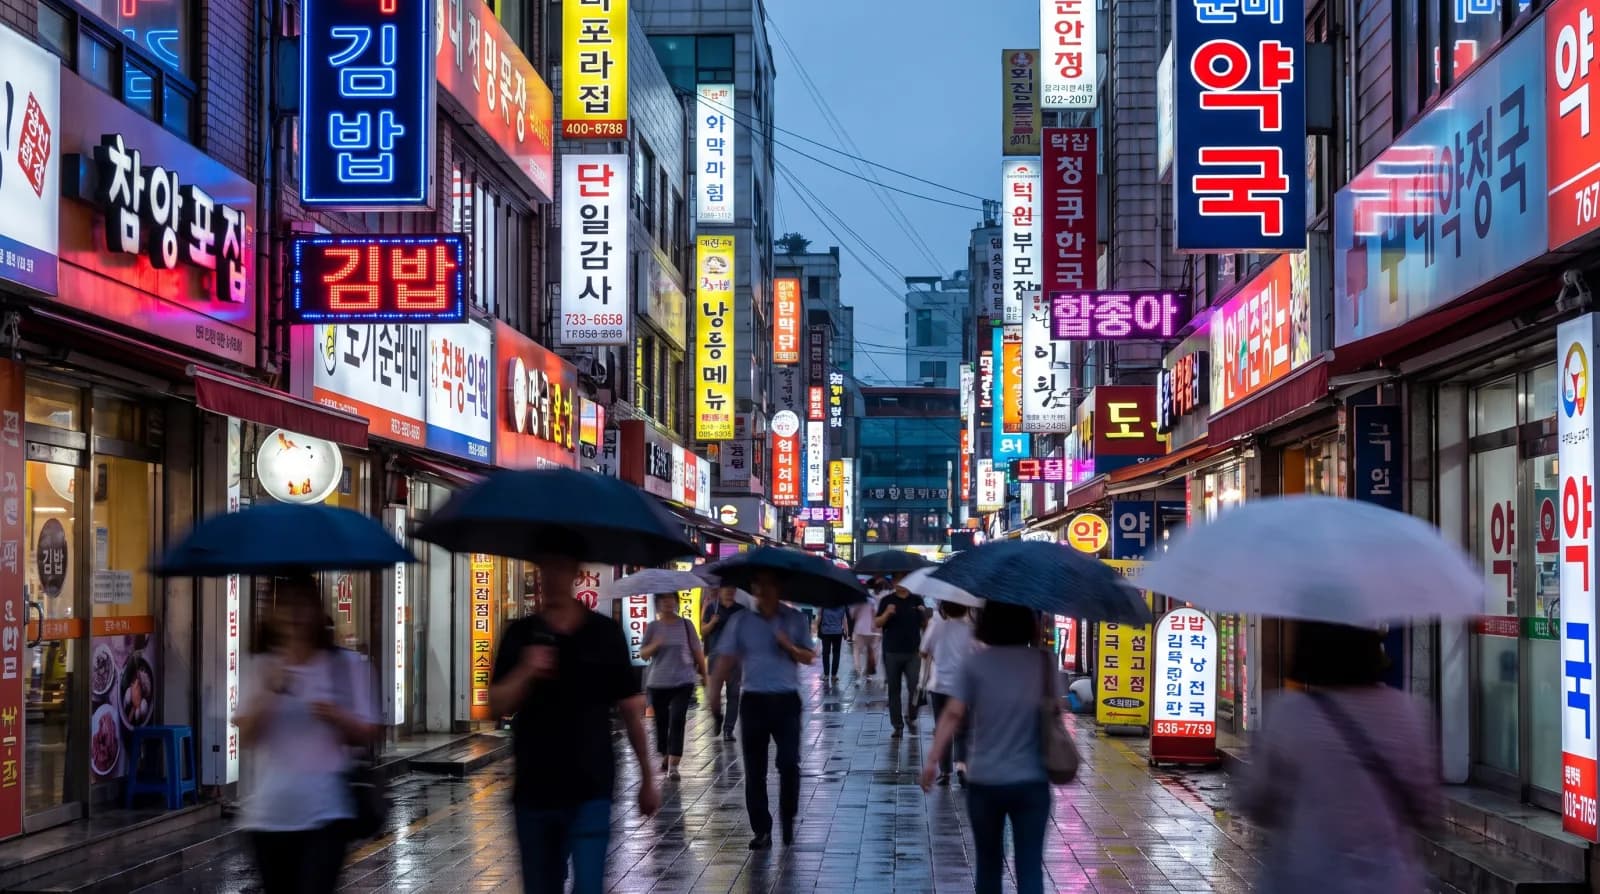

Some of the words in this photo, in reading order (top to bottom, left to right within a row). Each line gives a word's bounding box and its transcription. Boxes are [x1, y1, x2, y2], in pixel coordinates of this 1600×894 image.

[329, 26, 404, 182] 김밥
[1191, 39, 1294, 236] 약국
[578, 164, 615, 305] 단일감사
[323, 246, 455, 309] 김밥
[565, 313, 623, 326] 733-6658
[42, 548, 65, 576] 김밥
[1073, 521, 1103, 549] 약
[1169, 615, 1206, 632] 김밥
[1562, 475, 1593, 740] 약국
